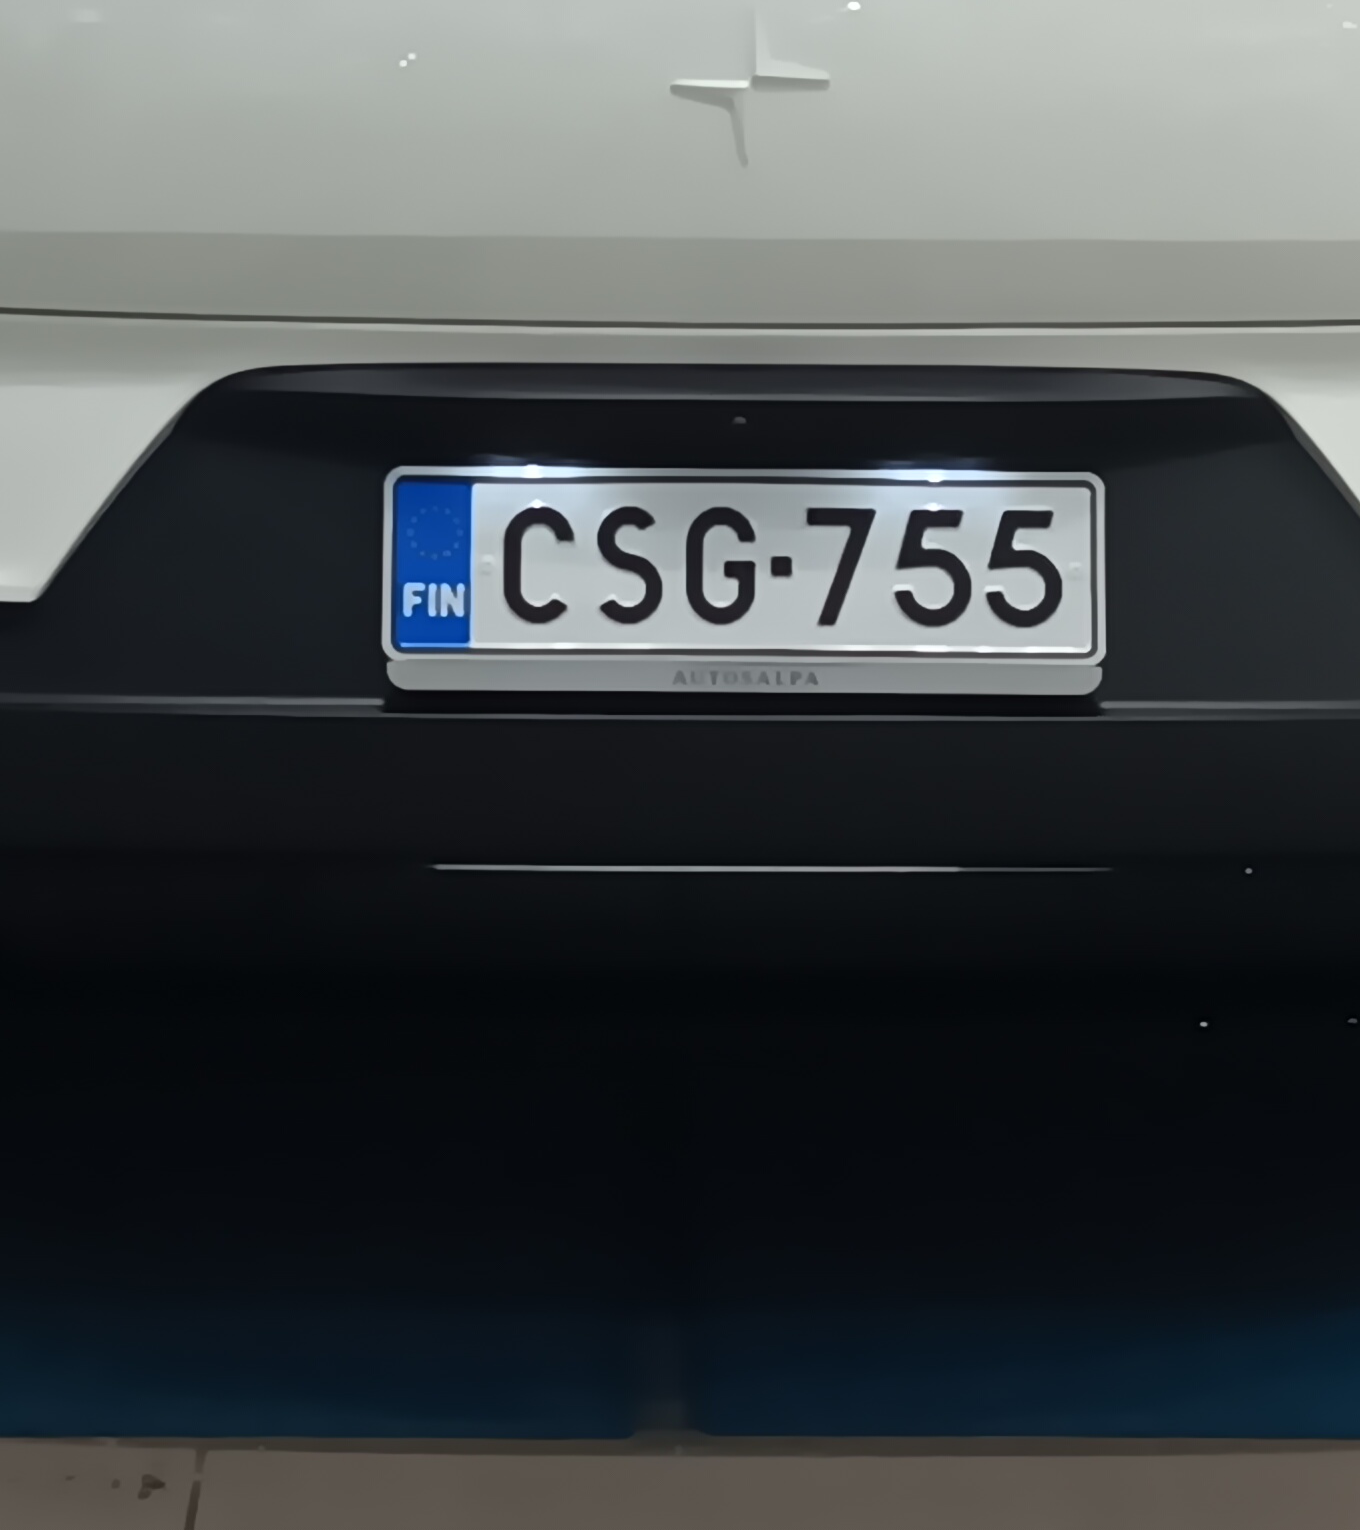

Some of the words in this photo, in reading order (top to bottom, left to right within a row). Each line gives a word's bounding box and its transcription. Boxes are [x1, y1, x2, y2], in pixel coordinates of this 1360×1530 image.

[502, 505, 1063, 628] CSG-755
[402, 581, 466, 618] FIN
[672, 670, 819, 686] AUTOSALPA
